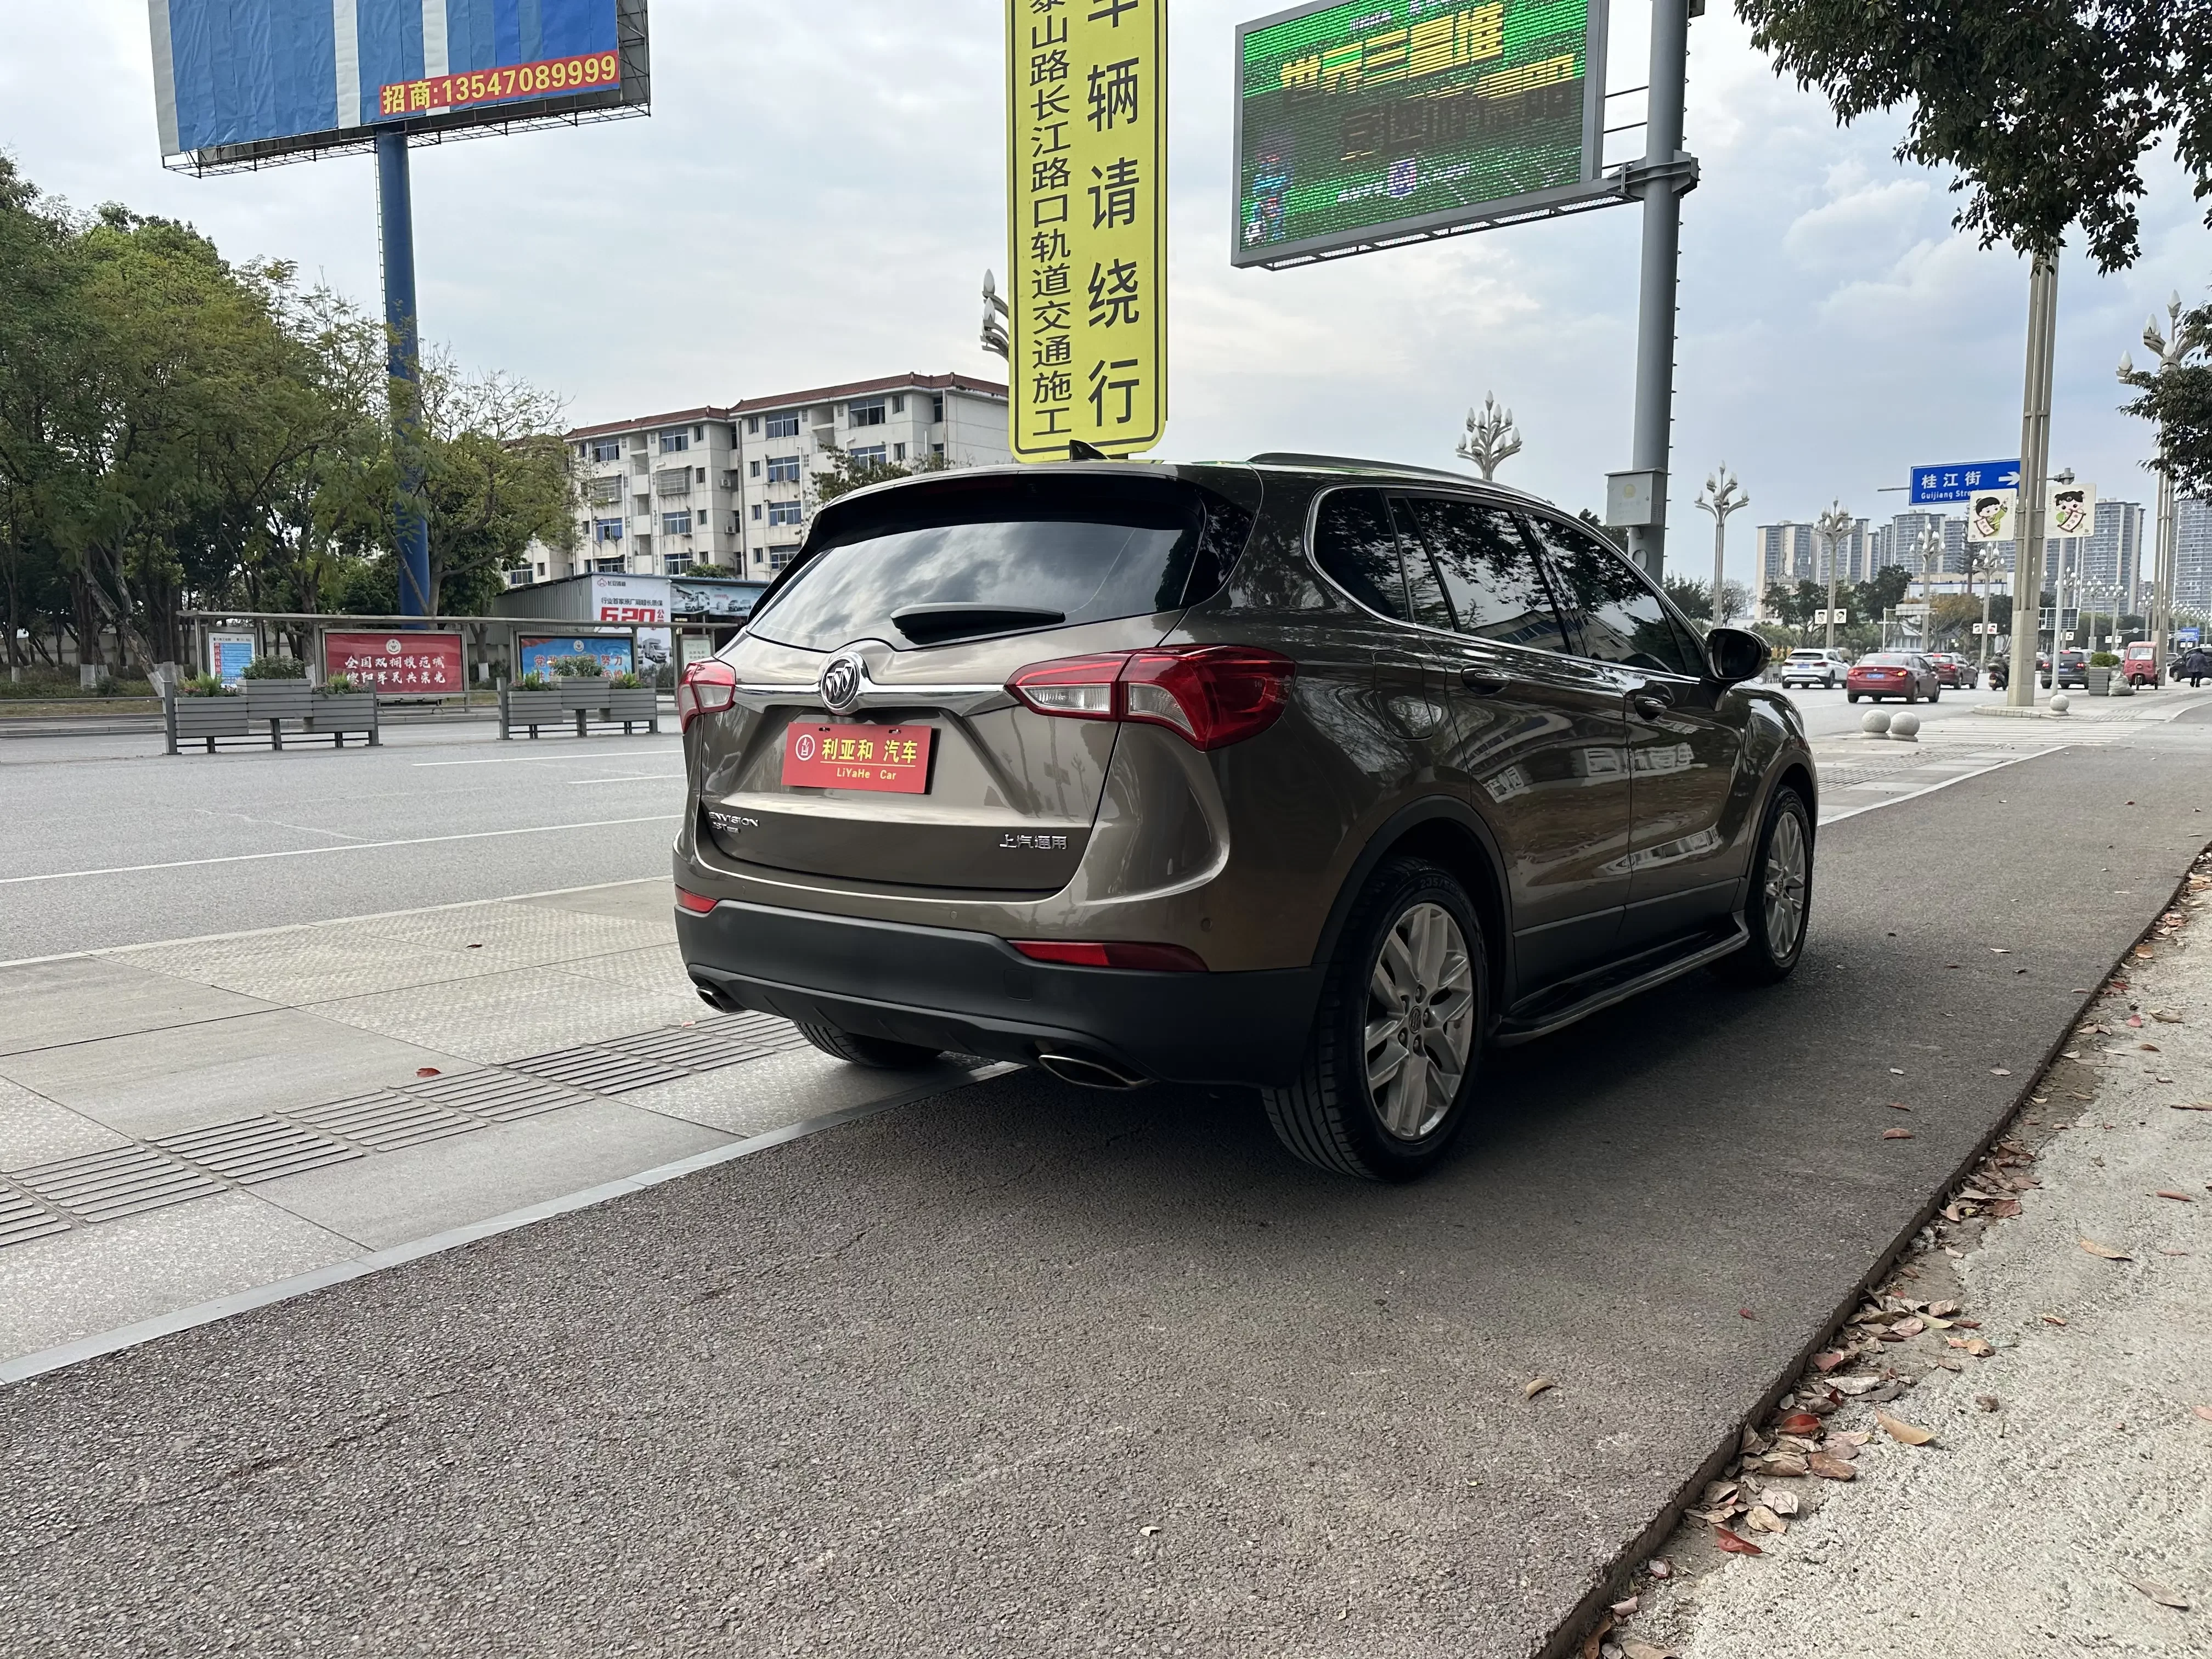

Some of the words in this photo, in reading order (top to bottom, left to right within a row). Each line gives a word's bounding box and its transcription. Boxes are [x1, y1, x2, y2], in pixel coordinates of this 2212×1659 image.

[382, 54, 617, 114] 招商:13547089999
[1921, 471, 1982, 489] 桂江街
[1921, 491, 1953, 500] Guijiang
[345, 655, 445, 669] 全国双拥模范城
[822, 738, 874, 761] 利亚和
[883, 740, 918, 764] 汽车
[837, 768, 871, 779] LiYaHe
[880, 769, 896, 780] Car
[708, 811, 760, 827] ENVISION
[999, 834, 1067, 850] 上汽通用
